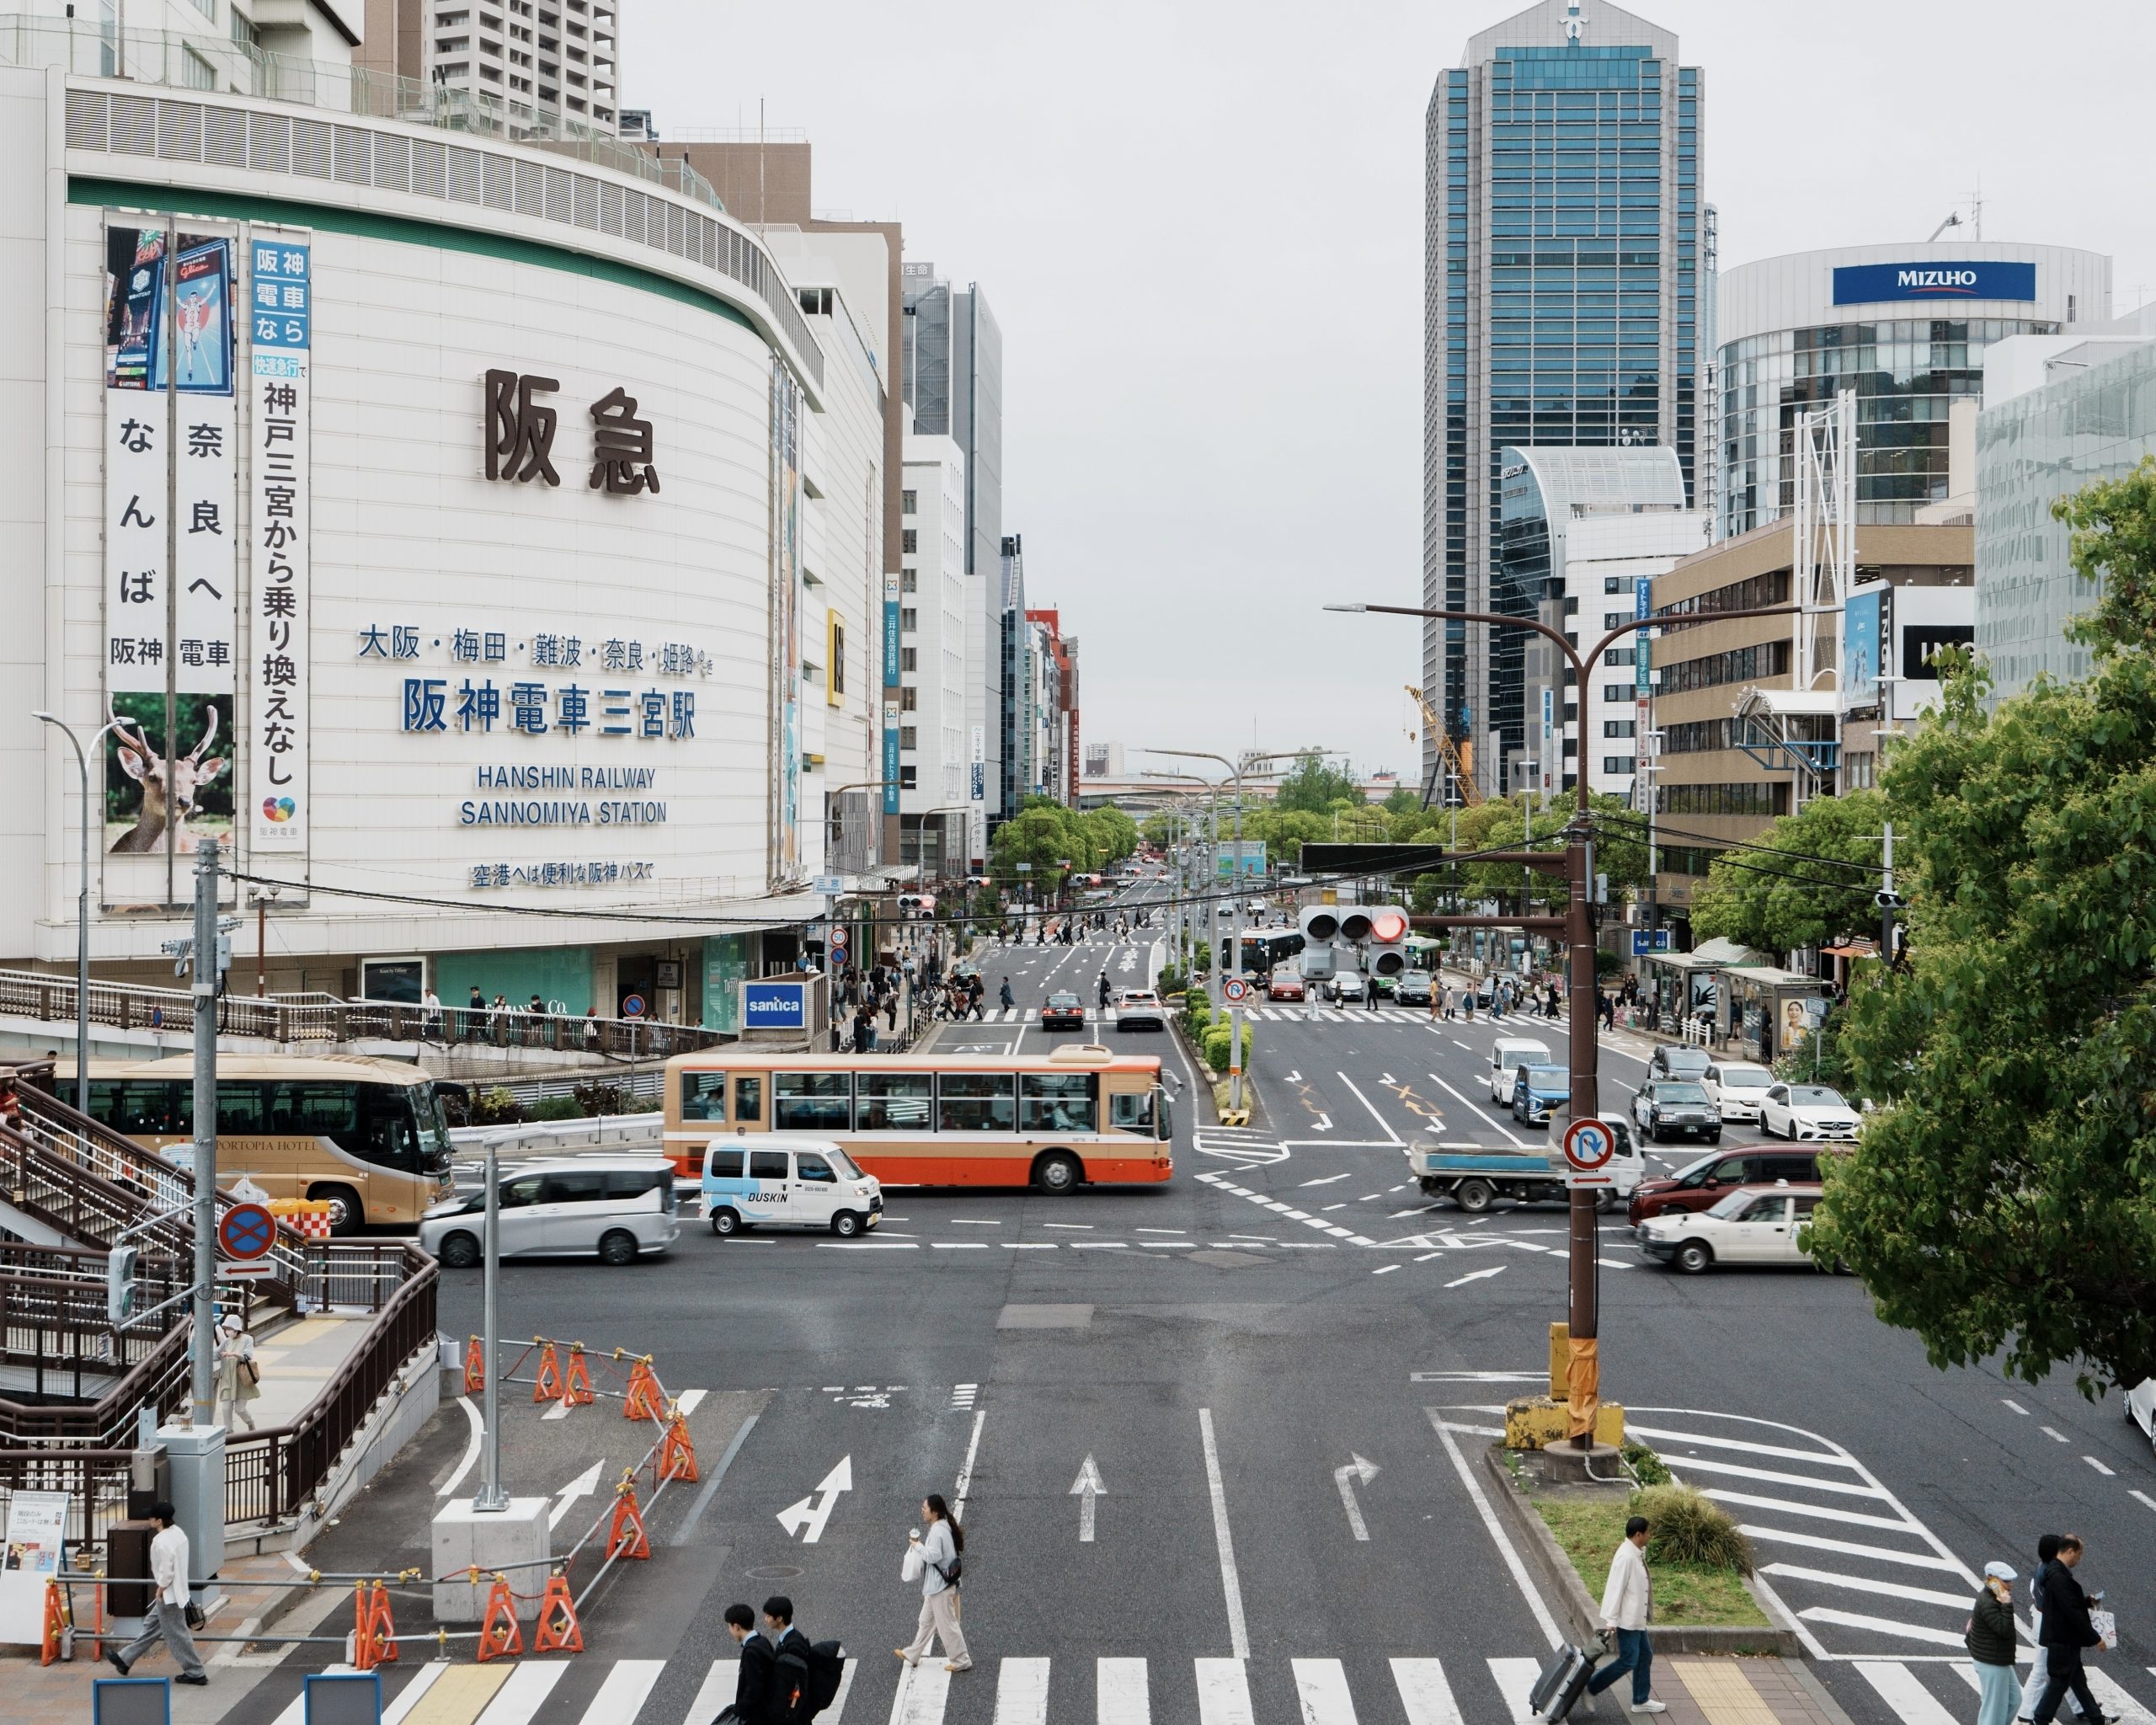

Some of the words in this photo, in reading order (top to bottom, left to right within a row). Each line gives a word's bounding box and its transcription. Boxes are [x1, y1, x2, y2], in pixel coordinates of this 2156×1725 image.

[257, 248, 304, 275] 阪神
[1897, 270, 1977, 286] MIZUHO
[257, 283, 304, 308] 電車
[257, 318, 303, 342] なら
[484, 367, 660, 495] 阪急
[119, 418, 157, 604] なんば
[187, 422, 223, 601] 奈良へ
[263, 382, 297, 785] 神戸三宮から乗り換えなし
[110, 638, 163, 665] 阪神
[179, 639, 230, 667] 電車
[404, 677, 695, 740] 阪神電車三宮駅
[478, 766, 574, 789] HANSHIN
[581, 766, 655, 789] RAILWAY
[461, 800, 590, 825] SANNOMIYA
[600, 800, 666, 824] STATION
[472, 860, 654, 888] 空港へは便利な阪神バスで
[749, 996, 799, 1012] santica
[216, 1140, 274, 1151] PORTOPIA
[277, 1140, 318, 1151] HOTEL
